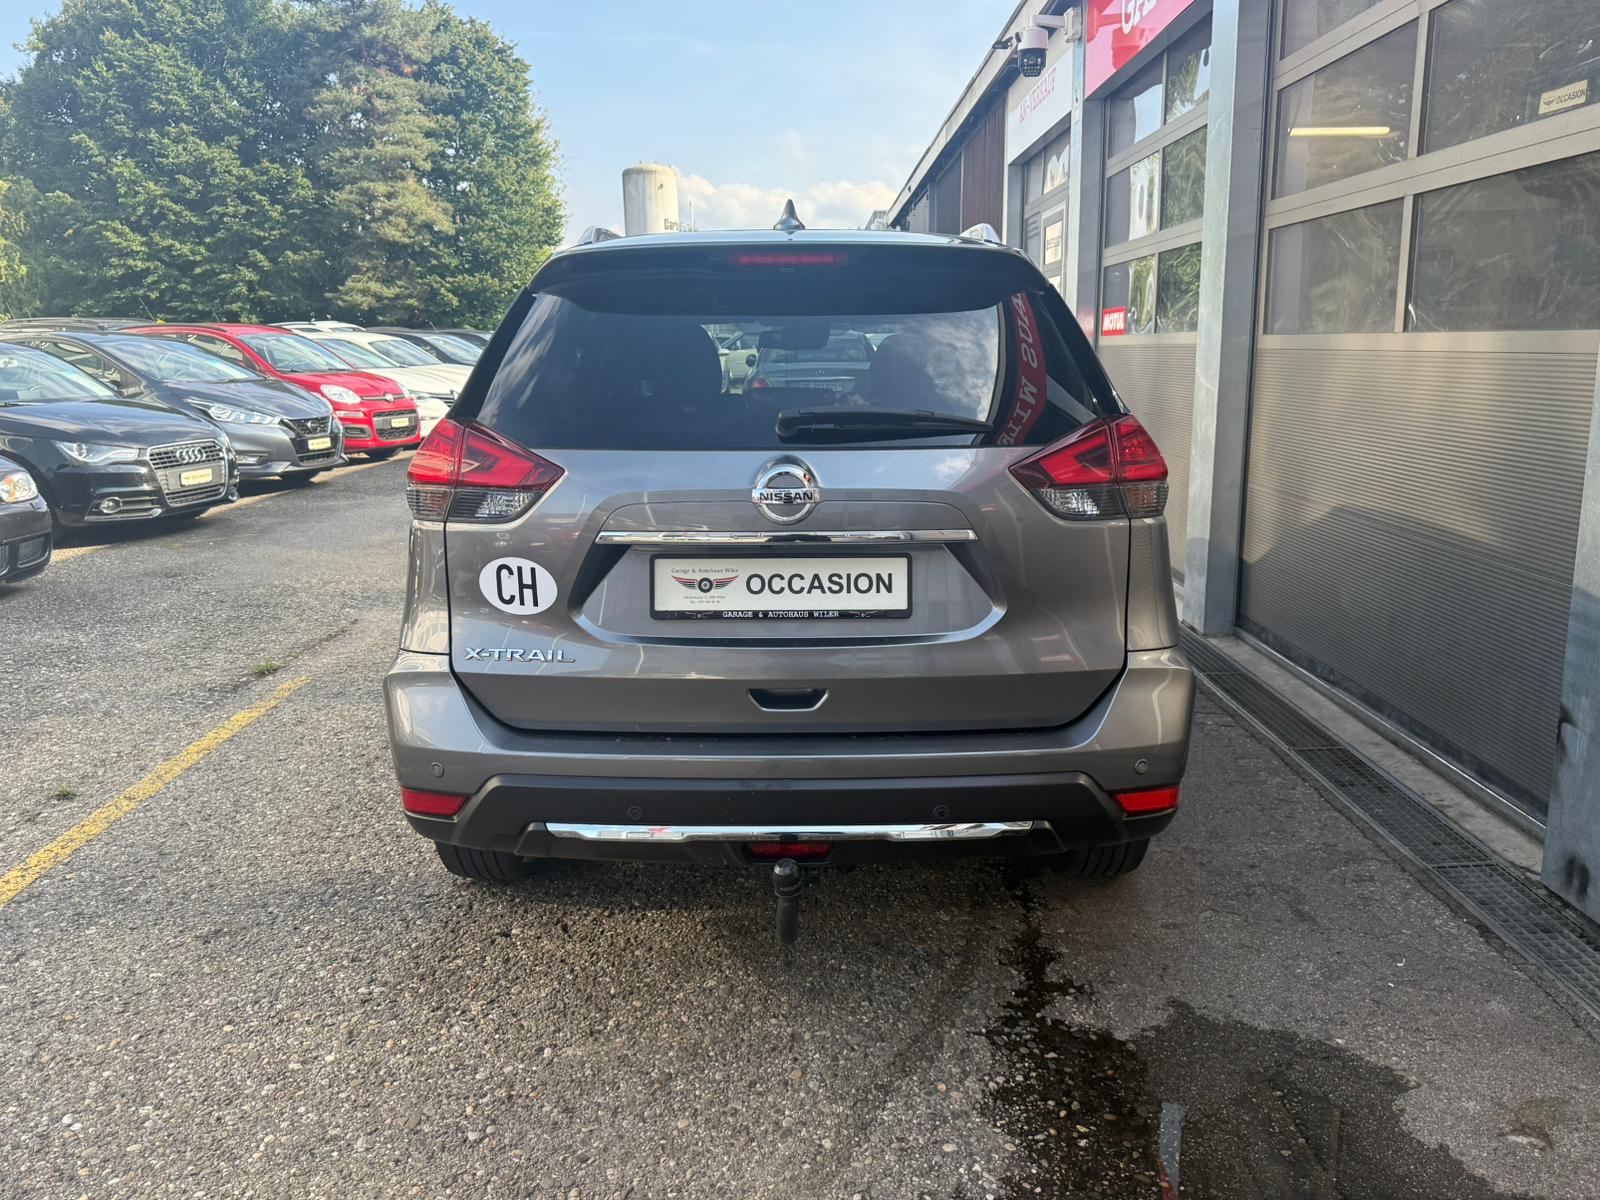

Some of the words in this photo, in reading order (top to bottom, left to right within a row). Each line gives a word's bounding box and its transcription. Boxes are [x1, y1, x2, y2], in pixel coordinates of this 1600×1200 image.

[1556, 89, 1586, 104] OCCASION
[1103, 311, 1124, 331] MOTUL
[759, 492, 813, 501] NISSAN
[671, 567, 690, 575] Garage
[495, 563, 539, 607] CH
[745, 572, 893, 595] OCCASION
[813, 610, 840, 618] WILER
[464, 647, 577, 664] X-TRAIL
